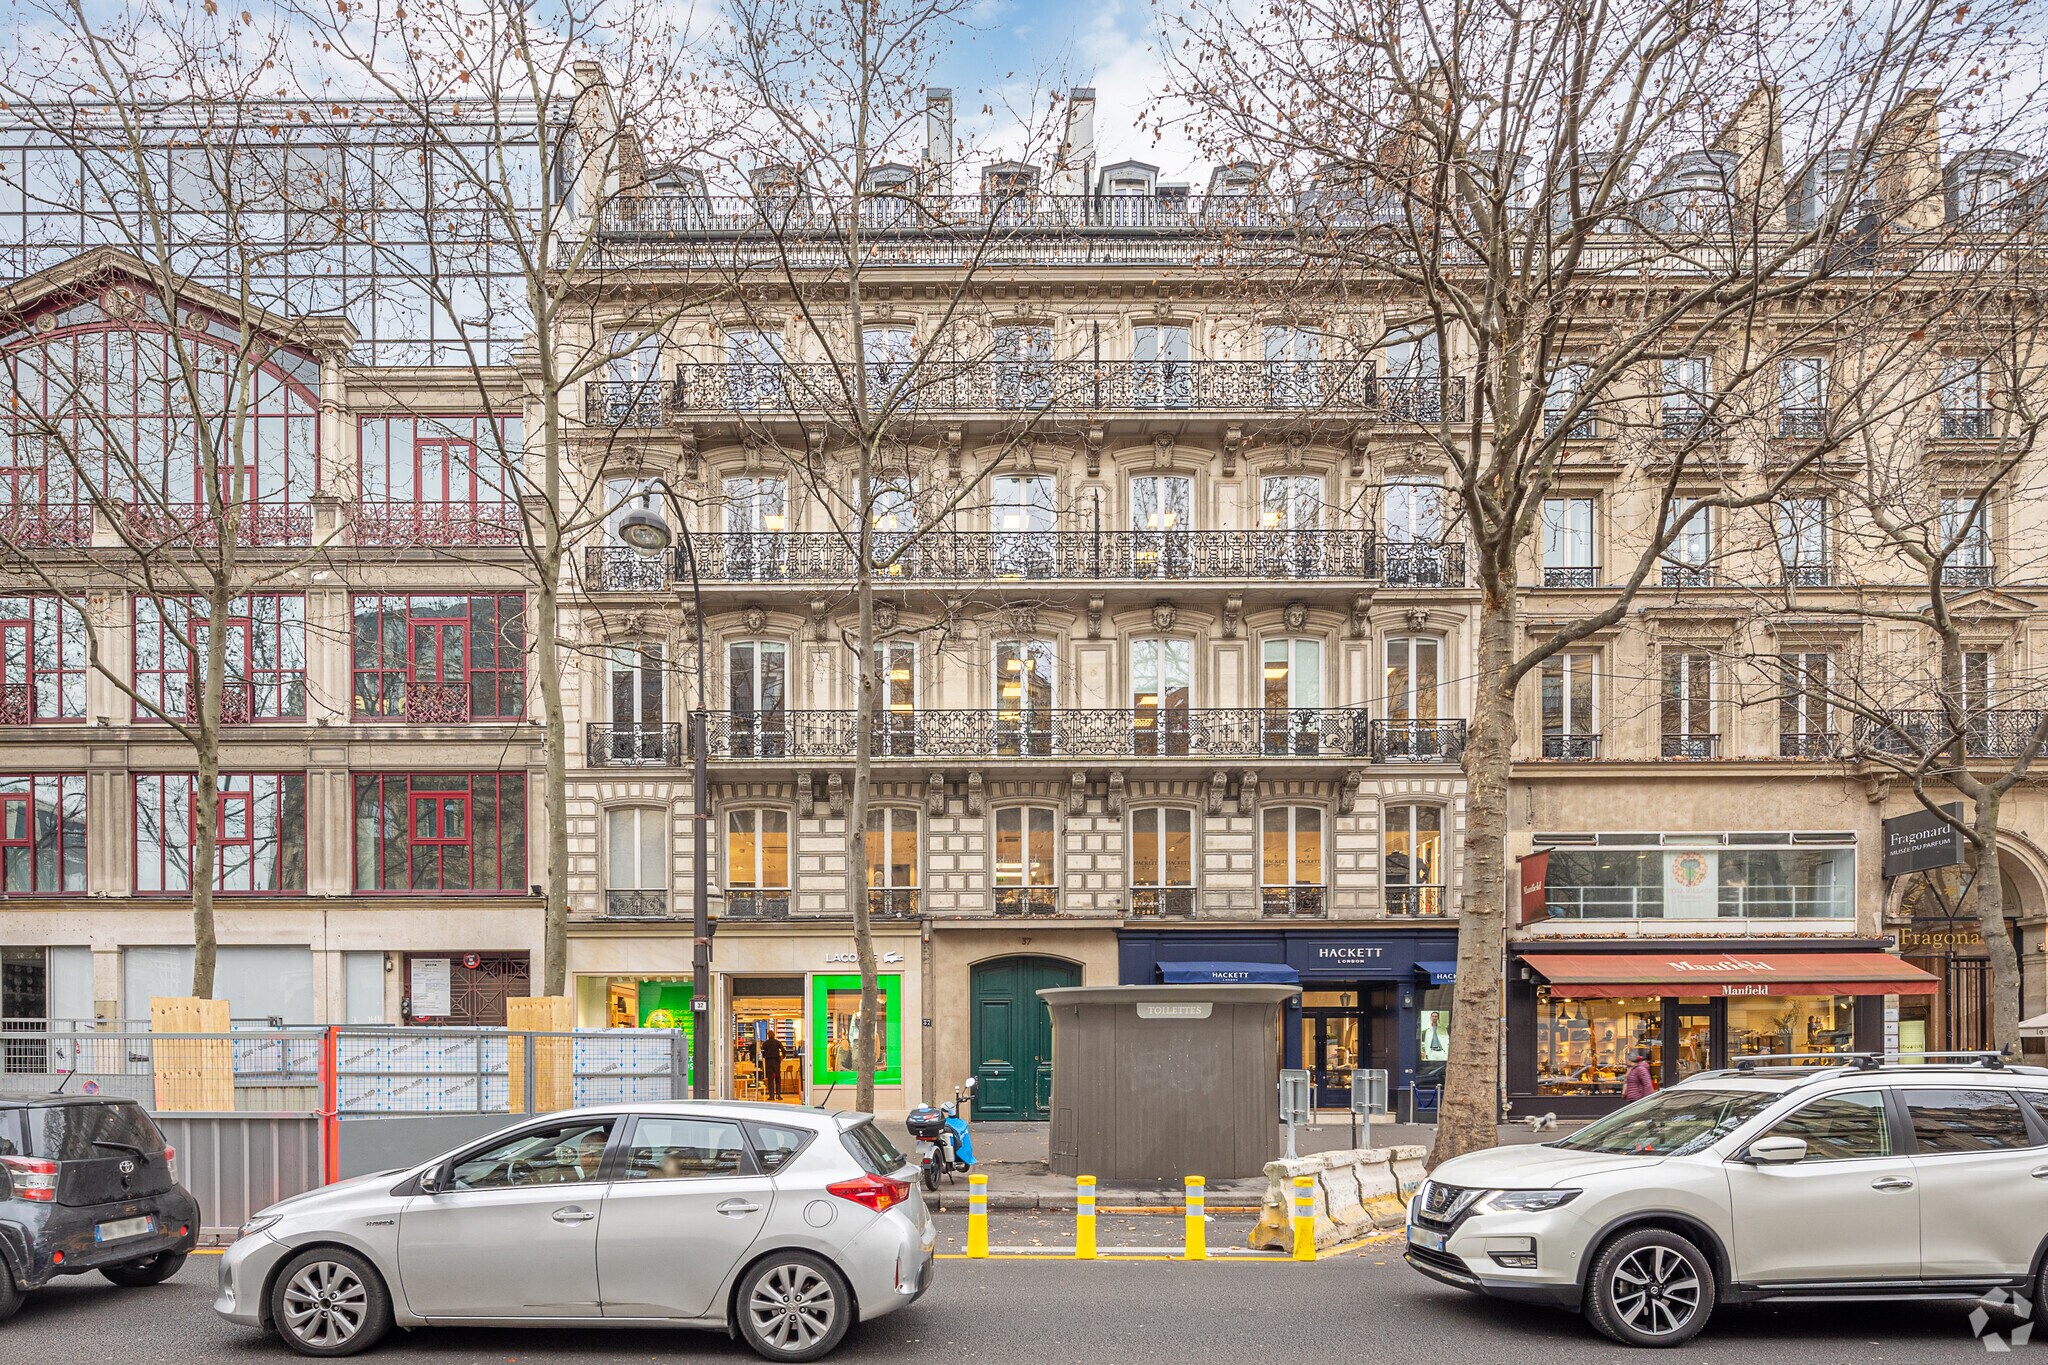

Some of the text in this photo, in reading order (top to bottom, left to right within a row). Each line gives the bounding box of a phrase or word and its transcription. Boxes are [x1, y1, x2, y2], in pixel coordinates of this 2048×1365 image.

[1890, 824, 1951, 846] Fragonard
[1889, 846, 1911, 856] MUSÉE
[1922, 838, 1951, 849] PARFUM
[1022, 938, 1032, 946] 37
[1901, 928, 1980, 949] Fragona
[825, 953, 878, 963] LACOE
[1319, 948, 1383, 958] HACKETT
[1666, 960, 1776, 972] Manfield
[1722, 984, 1769, 995] Manfield
[1148, 1006, 1202, 1015] TOILETTES
